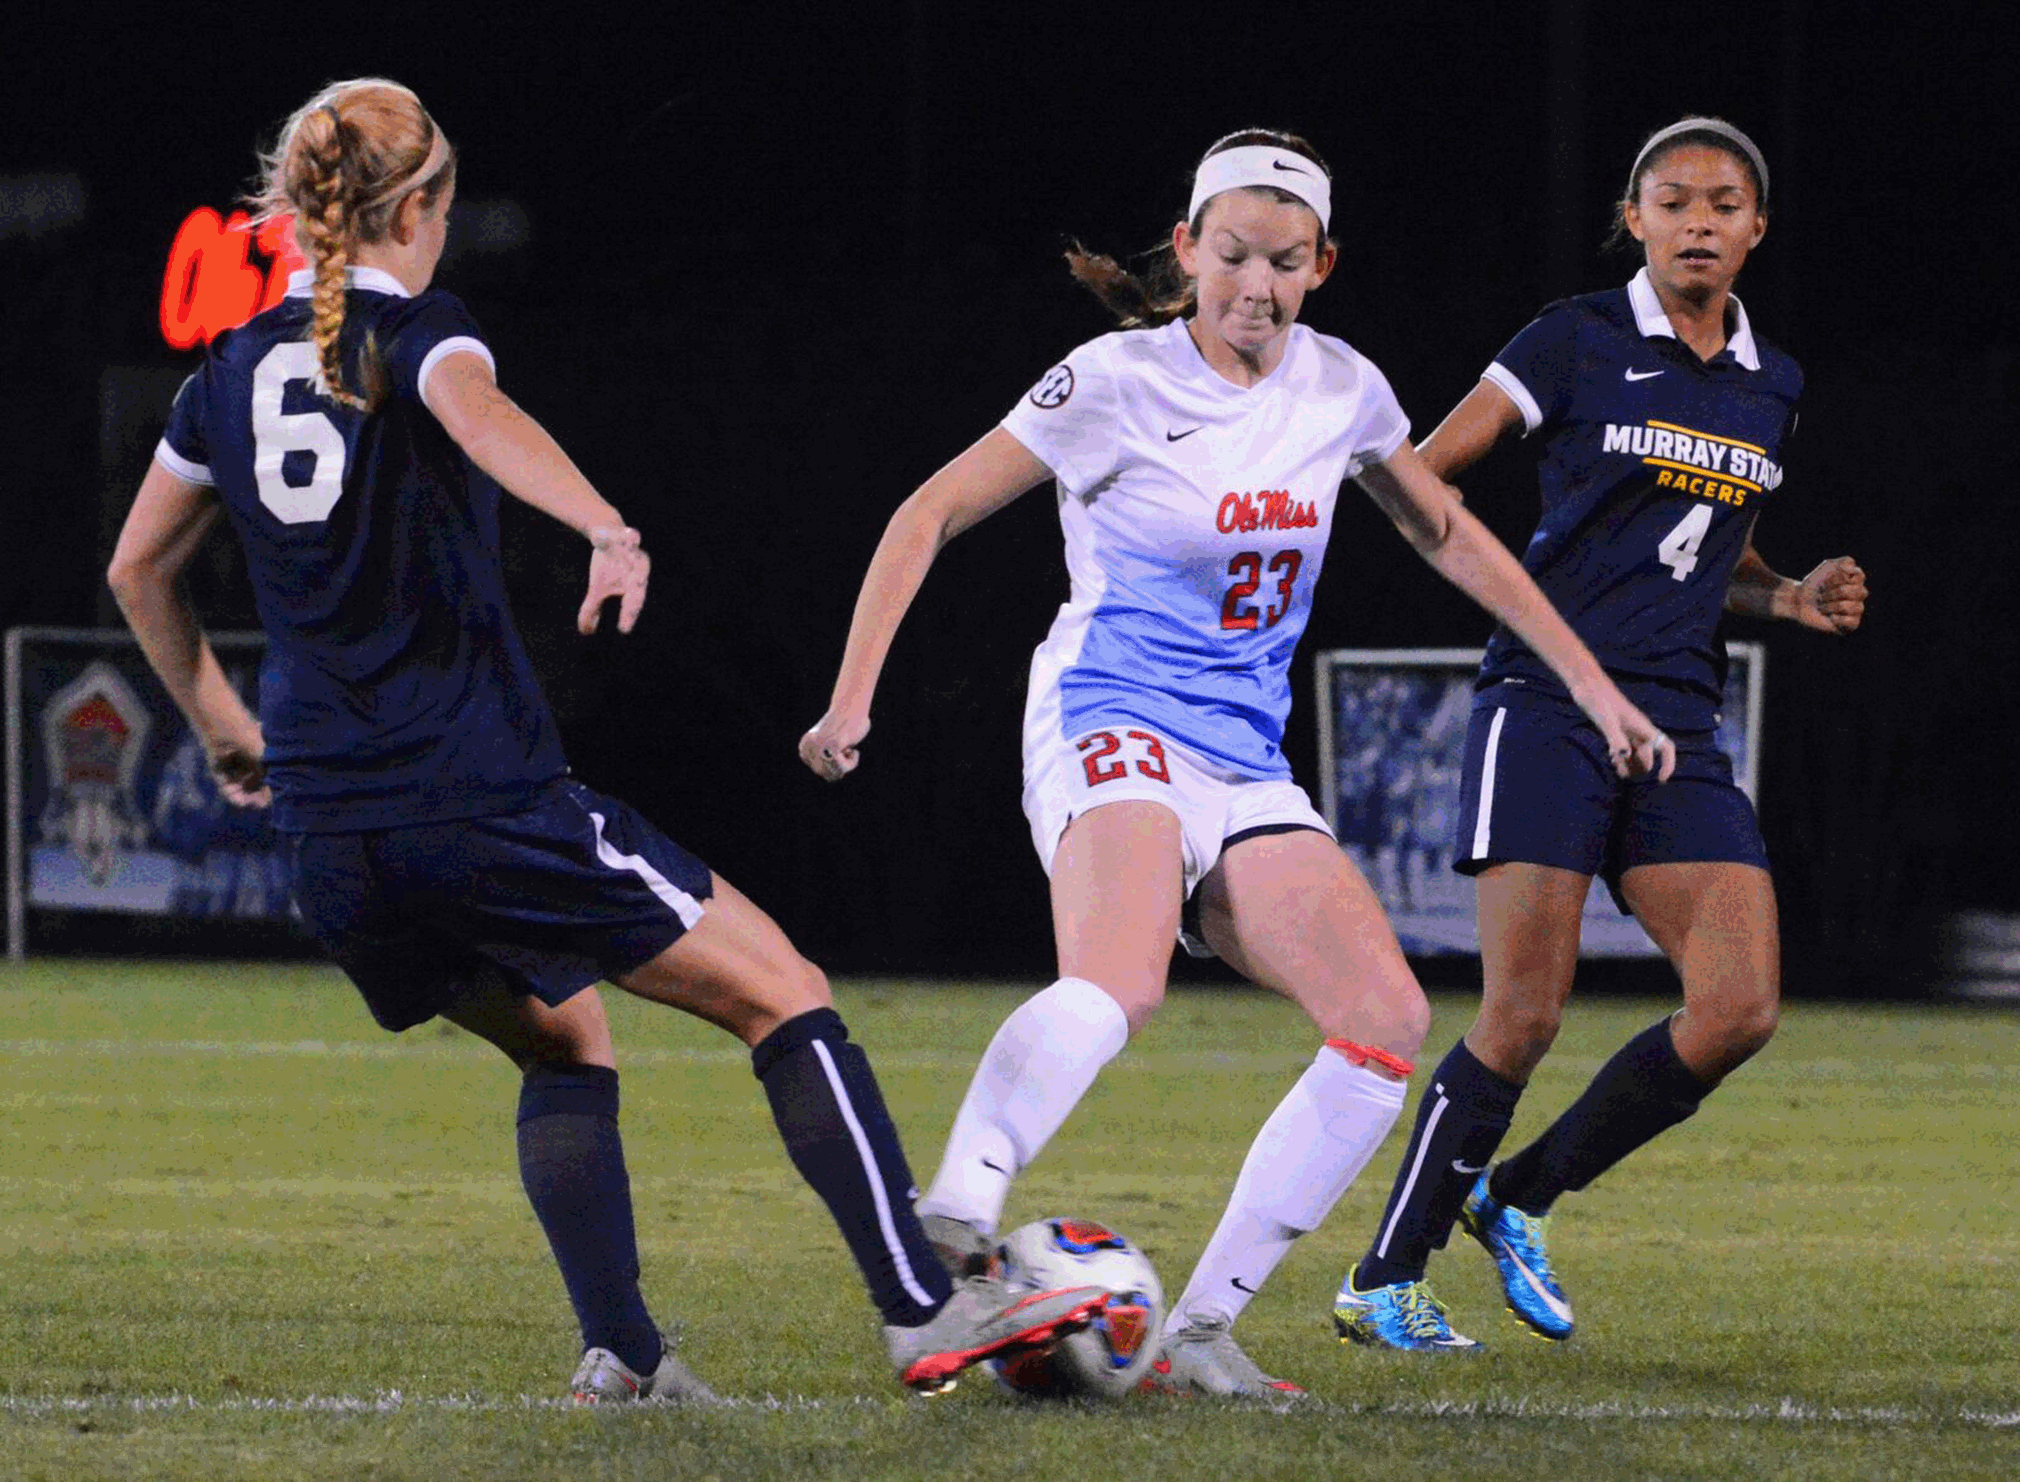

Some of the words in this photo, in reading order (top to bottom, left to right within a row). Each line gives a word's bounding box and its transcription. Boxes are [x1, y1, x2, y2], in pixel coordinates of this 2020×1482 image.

[252, 341, 346, 525] 6
[1602, 424, 1728, 471] MURRAY
[1216, 491, 1259, 534] Ole
[1257, 489, 1319, 530] Miss
[1656, 470, 1747, 506] RACERS
[1658, 503, 1713, 582] 4
[1220, 549, 1303, 630] 23
[1076, 730, 1171, 788] 23
